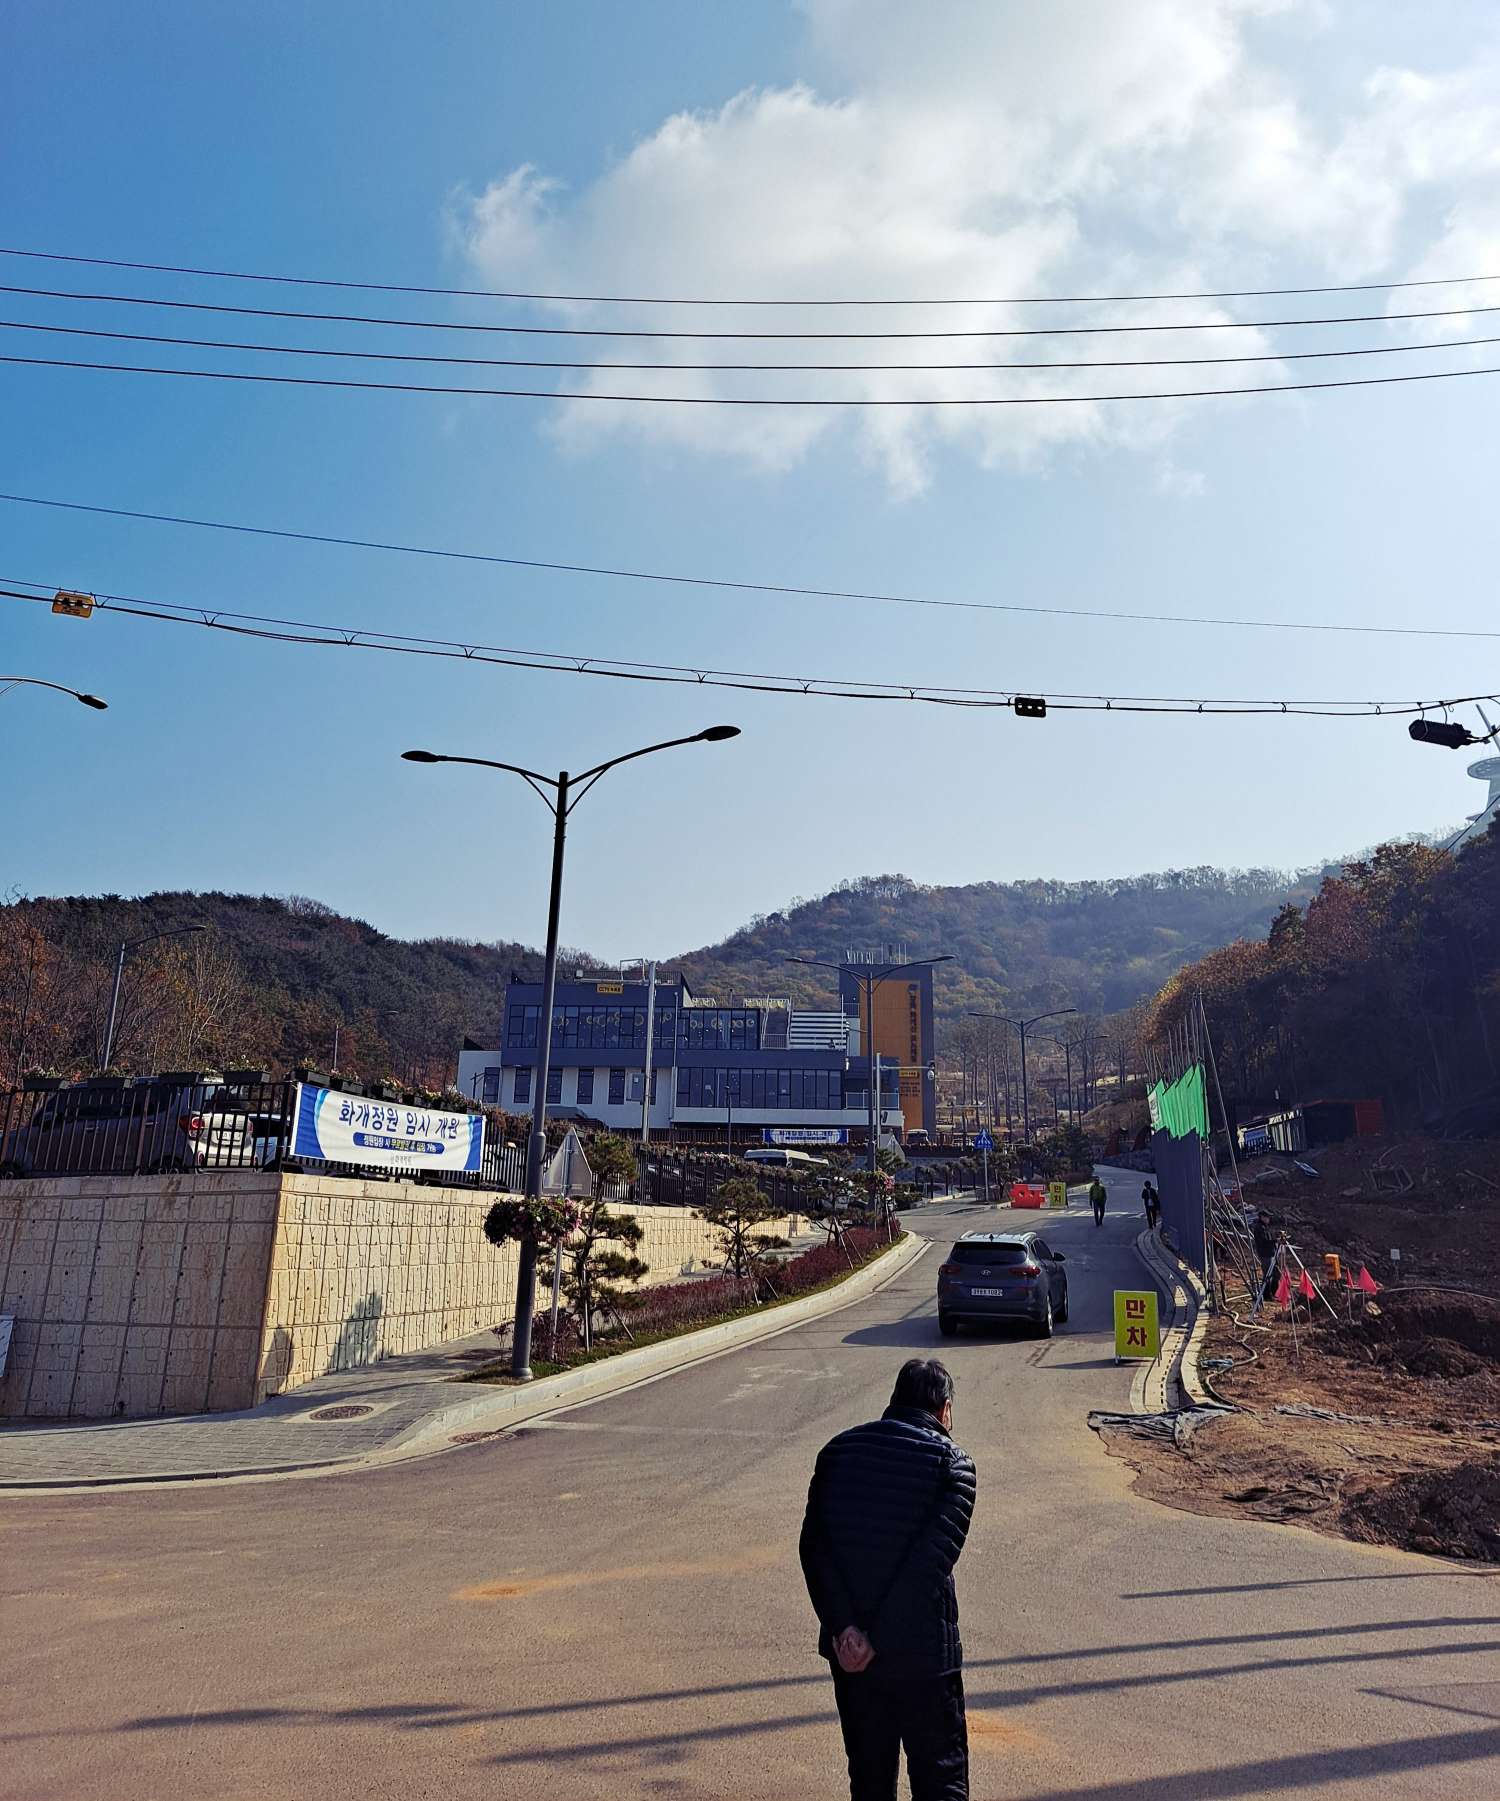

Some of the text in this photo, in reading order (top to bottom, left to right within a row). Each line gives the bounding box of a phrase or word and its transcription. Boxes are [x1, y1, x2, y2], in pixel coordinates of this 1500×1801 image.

[339, 1100, 460, 1139] 화개정원 임시 개원
[1126, 1299, 1147, 1346] 만차
